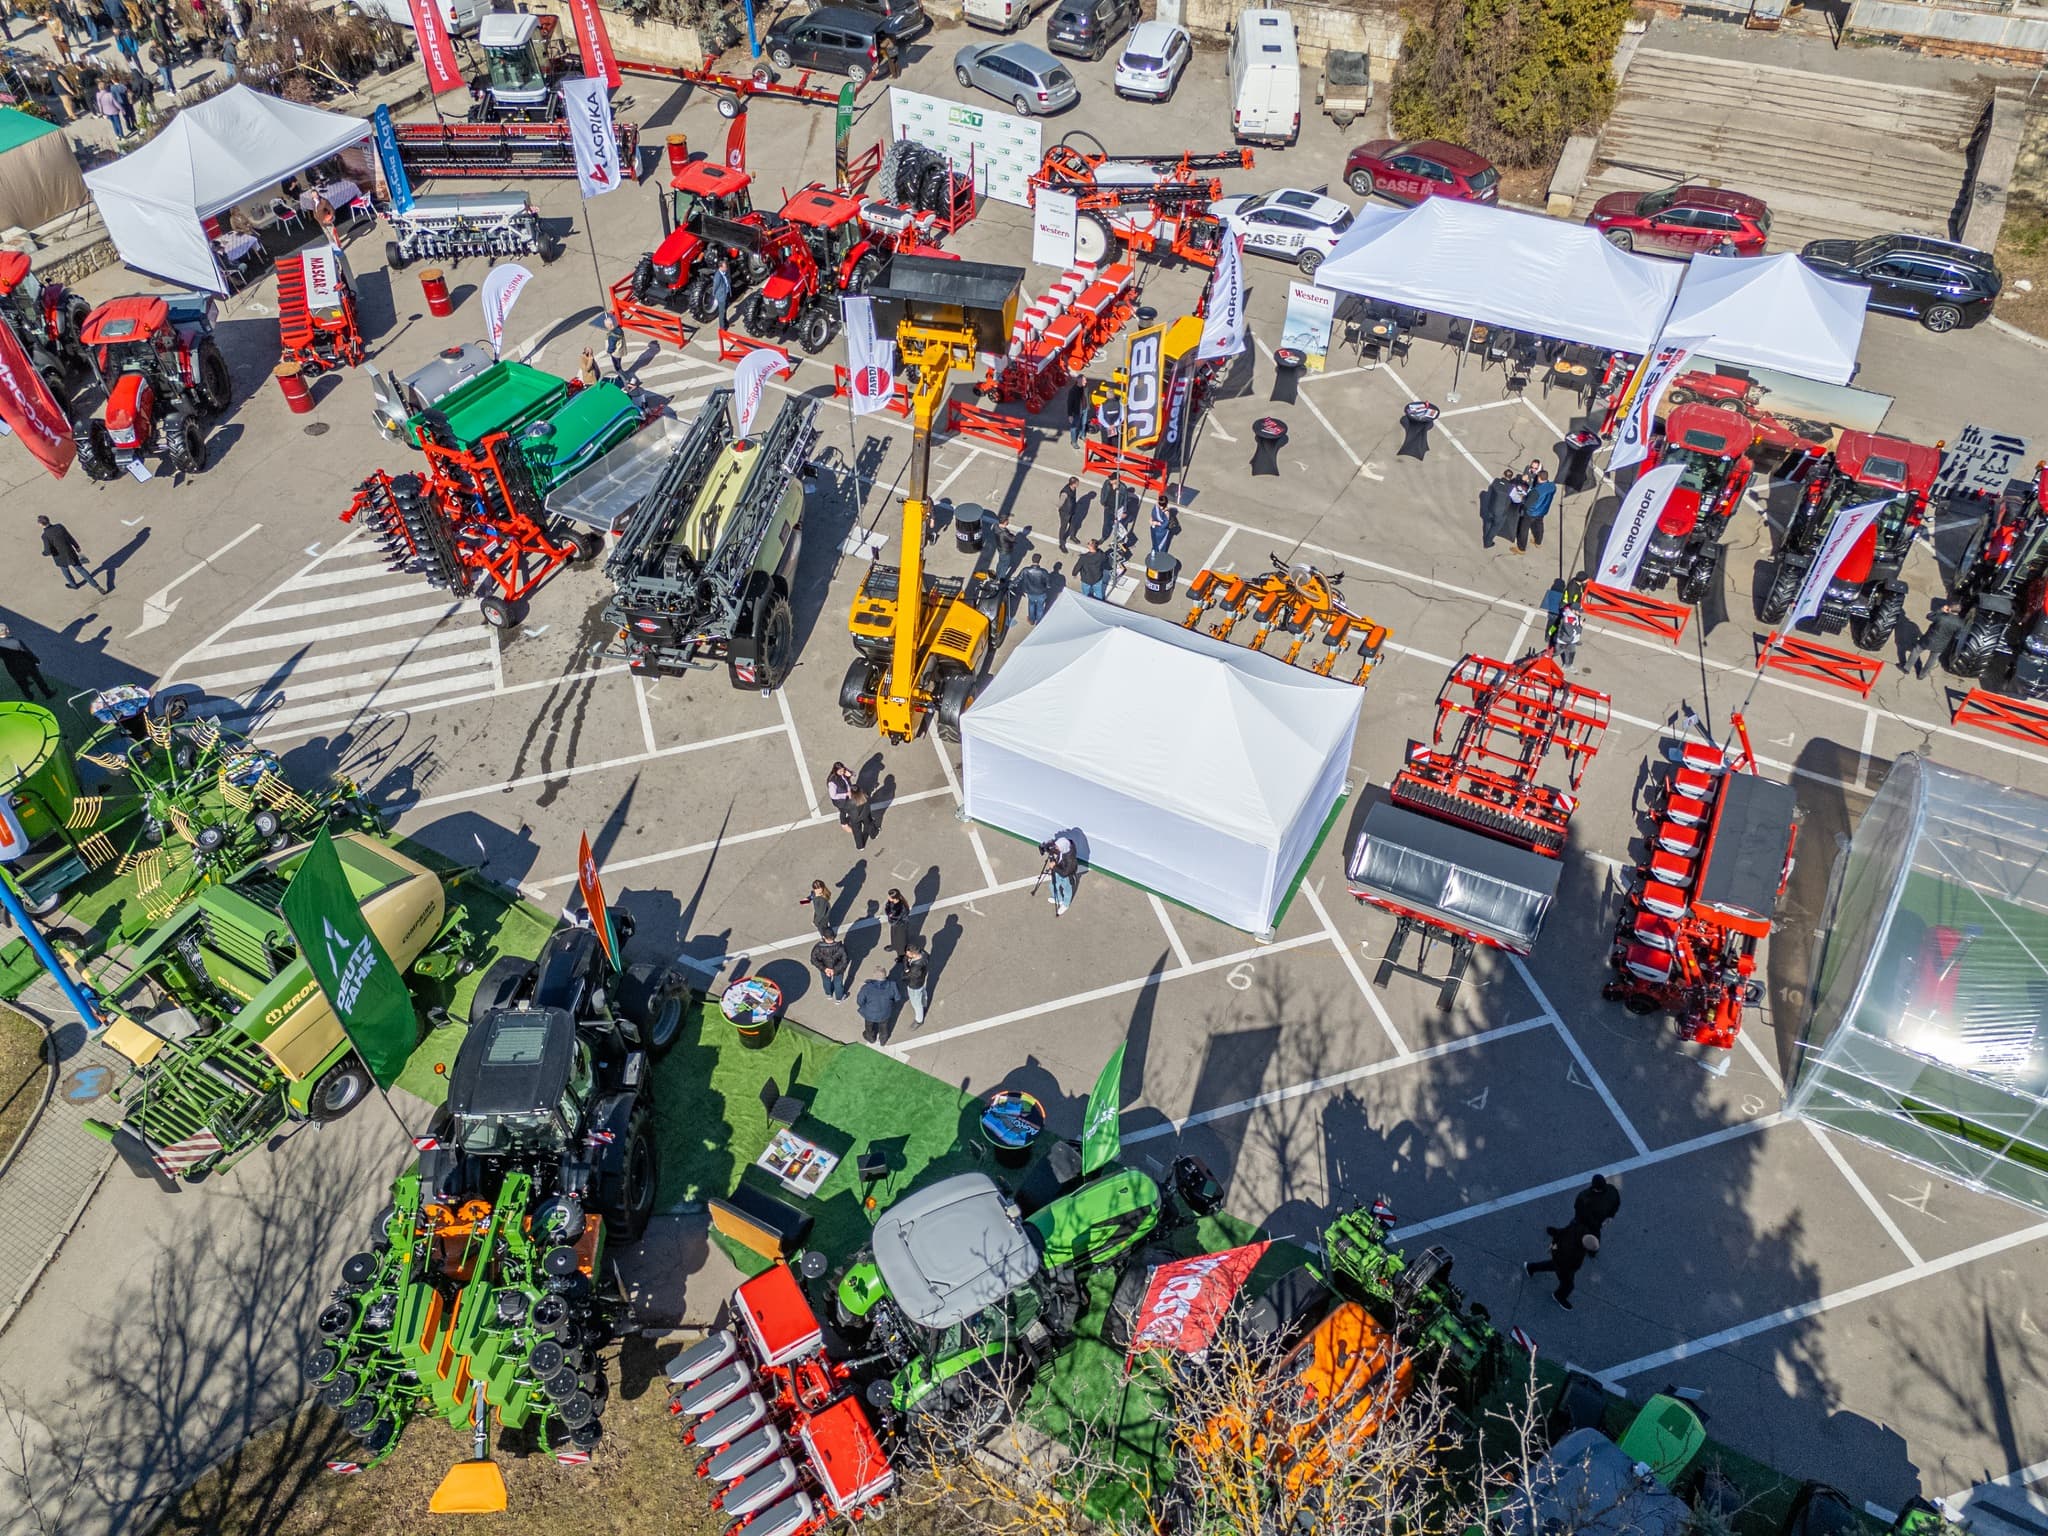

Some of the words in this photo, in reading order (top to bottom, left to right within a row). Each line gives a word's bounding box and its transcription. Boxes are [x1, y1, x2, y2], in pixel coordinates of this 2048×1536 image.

[587, 91, 606, 163] AGRIKA
[949, 107, 983, 127] BKT
[1376, 178, 1418, 194] CASE
[1040, 224, 1070, 238] Western
[310, 257, 327, 289] MASCAR
[1294, 287, 1329, 305] Western
[1127, 336, 1158, 438] JCB
[1611, 488, 1656, 559] AGROPROFI
[336, 934, 372, 1010] DEUTZ
[344, 953, 377, 1015] FAHR
